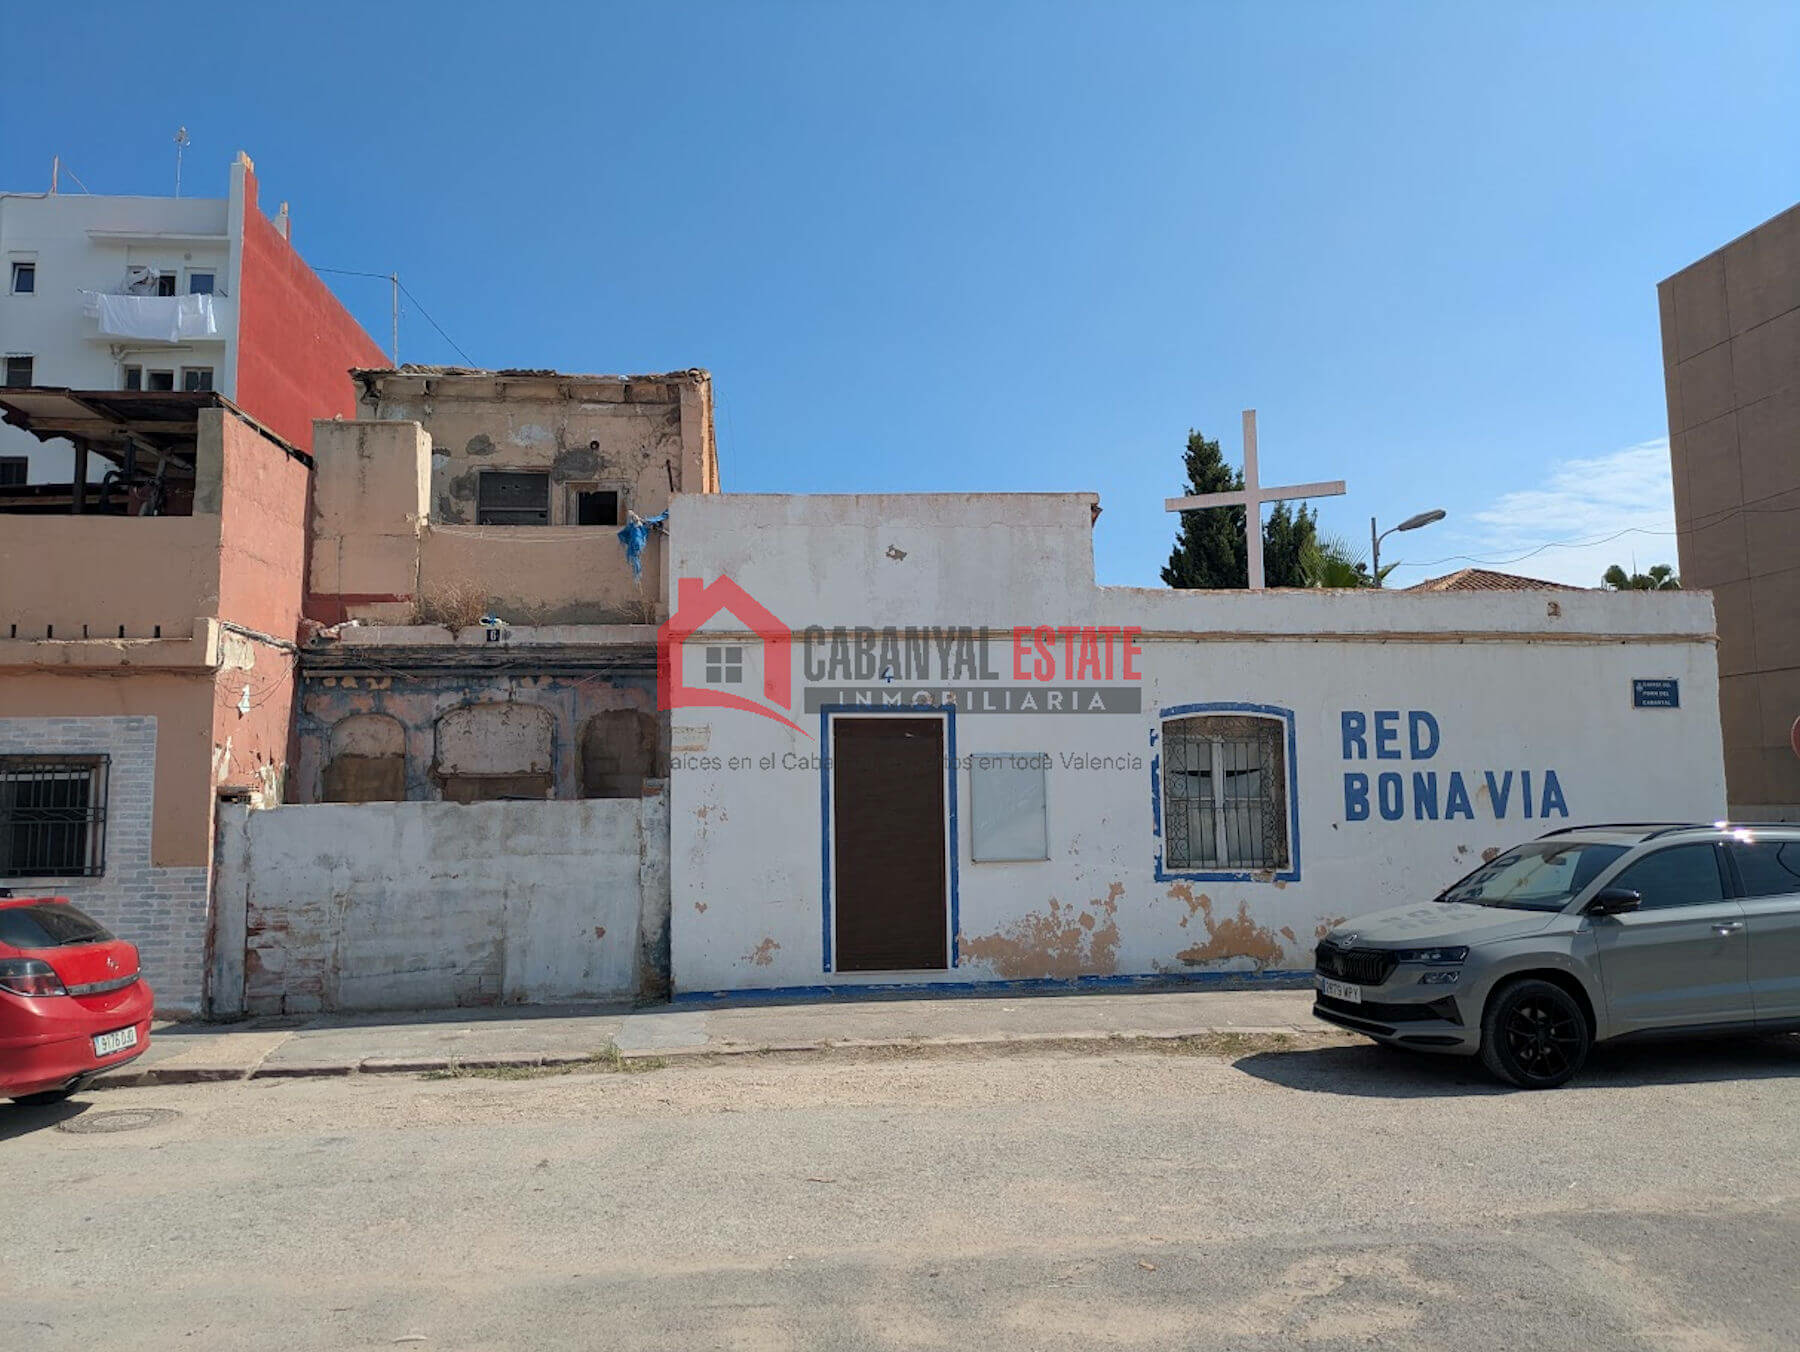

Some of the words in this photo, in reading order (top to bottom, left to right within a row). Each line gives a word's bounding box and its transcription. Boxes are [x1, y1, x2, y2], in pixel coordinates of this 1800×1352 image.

[881, 666, 895, 684] 4
[1341, 710, 1440, 761] RED
[1344, 769, 1570, 822] BONAVIA
